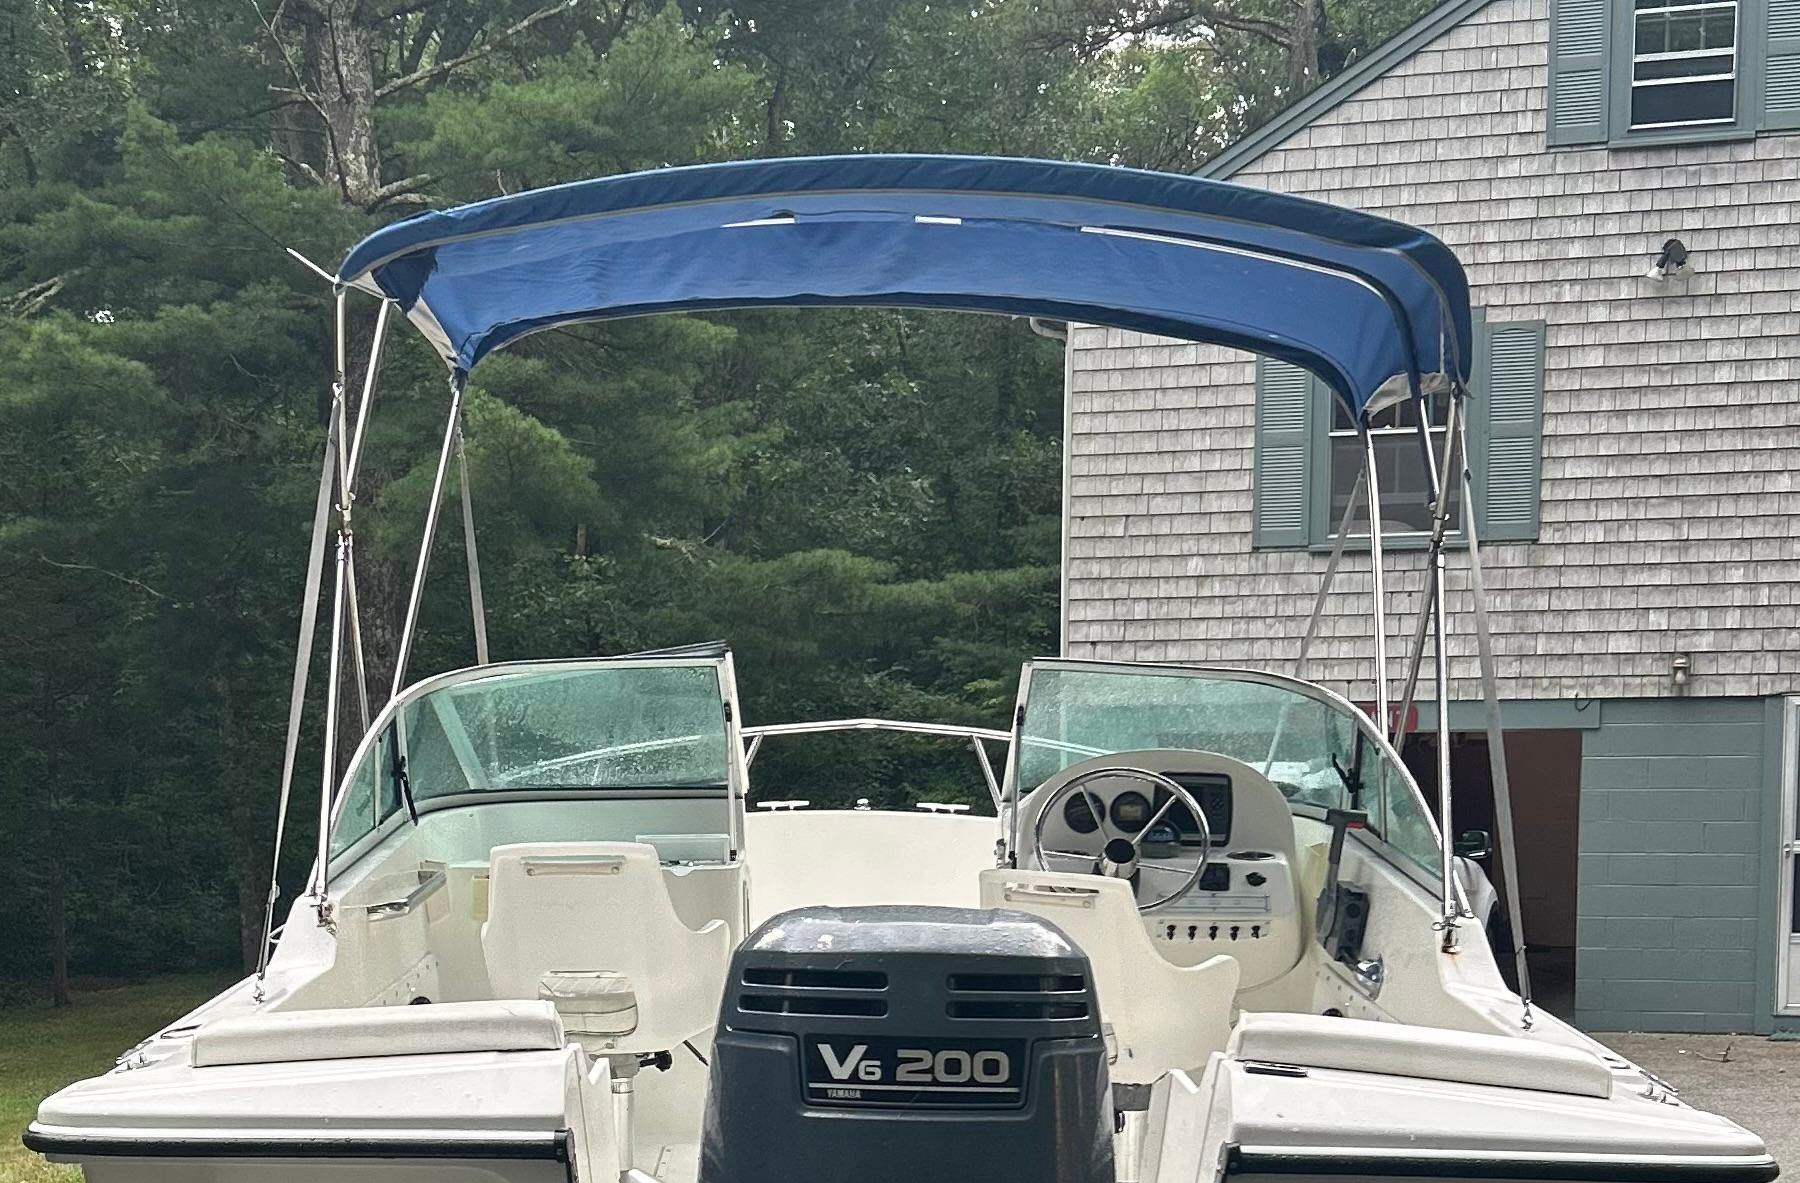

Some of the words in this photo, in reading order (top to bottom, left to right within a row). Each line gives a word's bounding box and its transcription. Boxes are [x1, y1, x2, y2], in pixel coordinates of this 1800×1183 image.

[816, 1043, 883, 1081] V6
[895, 1048, 1010, 1084] 200
[826, 1088, 862, 1099] YAMAHA
